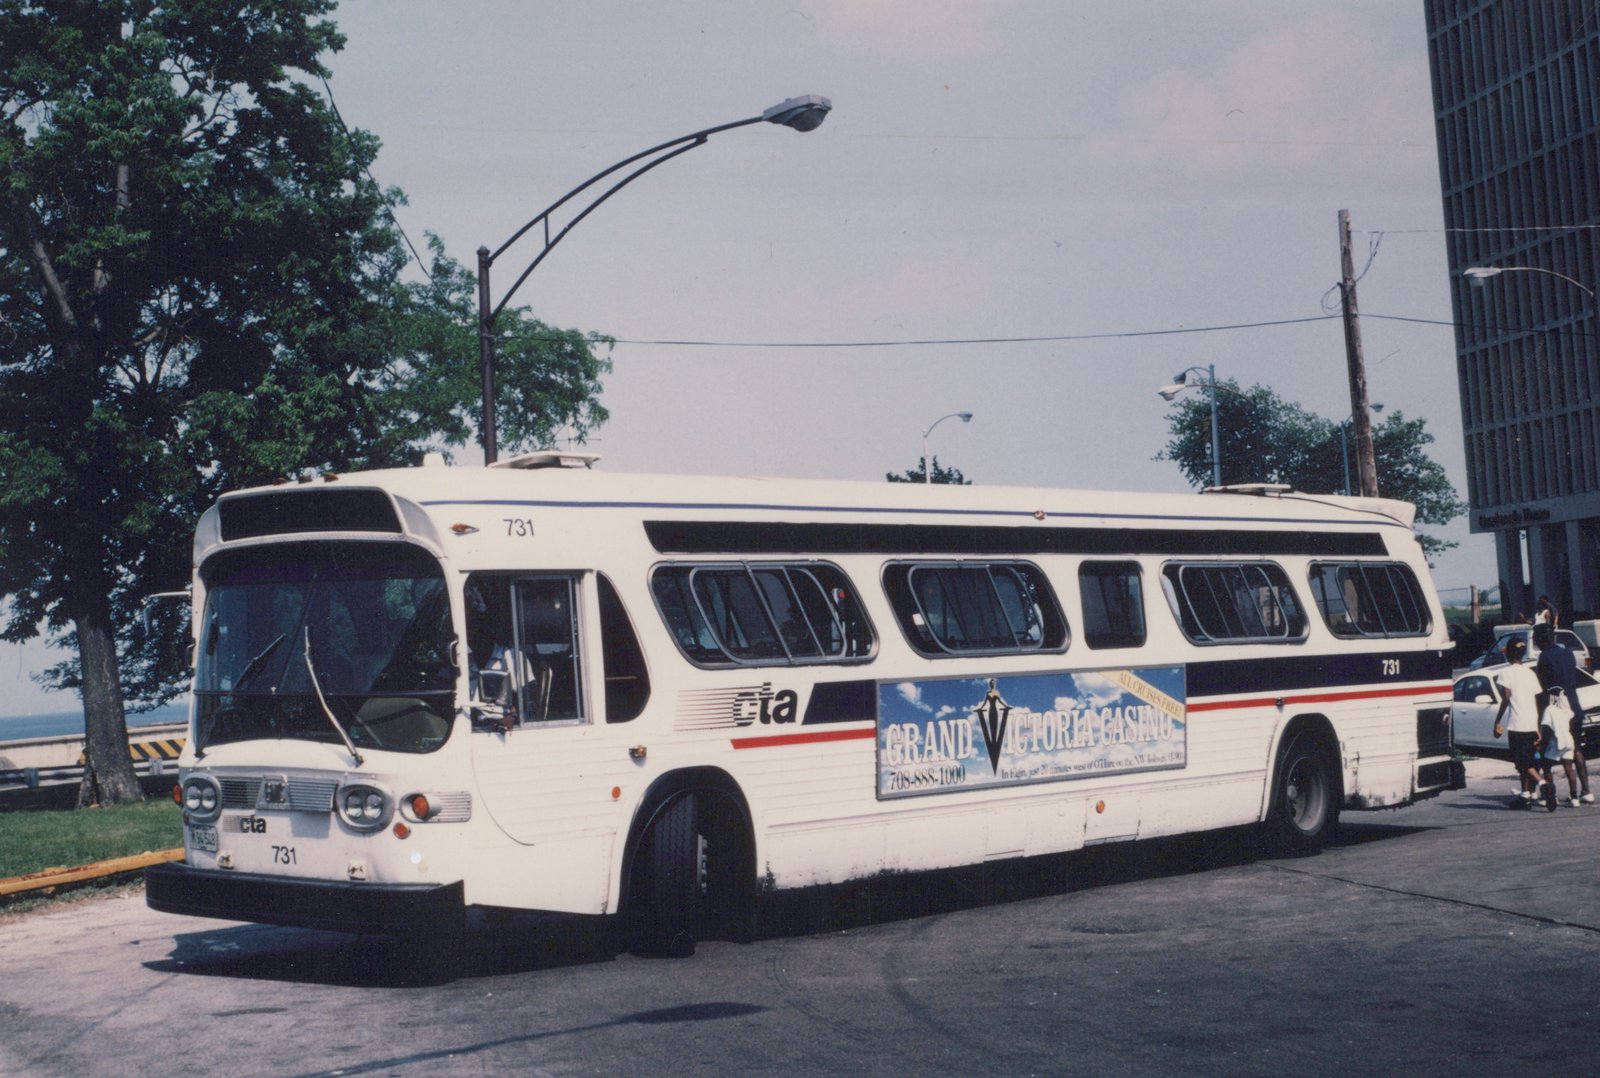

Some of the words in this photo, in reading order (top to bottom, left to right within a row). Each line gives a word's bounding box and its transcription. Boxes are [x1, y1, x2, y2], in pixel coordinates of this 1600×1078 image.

[503, 518, 534, 537] 731
[1382, 659, 1400, 676] 731
[732, 682, 798, 727] cta
[885, 719, 973, 767] GRAND
[973, 706, 1096, 777] VICTORIA
[1100, 704, 1174, 746] CASINO
[890, 764, 967, 790] 708-888-1000
[240, 815, 266, 833] cta
[271, 845, 297, 865] 731
